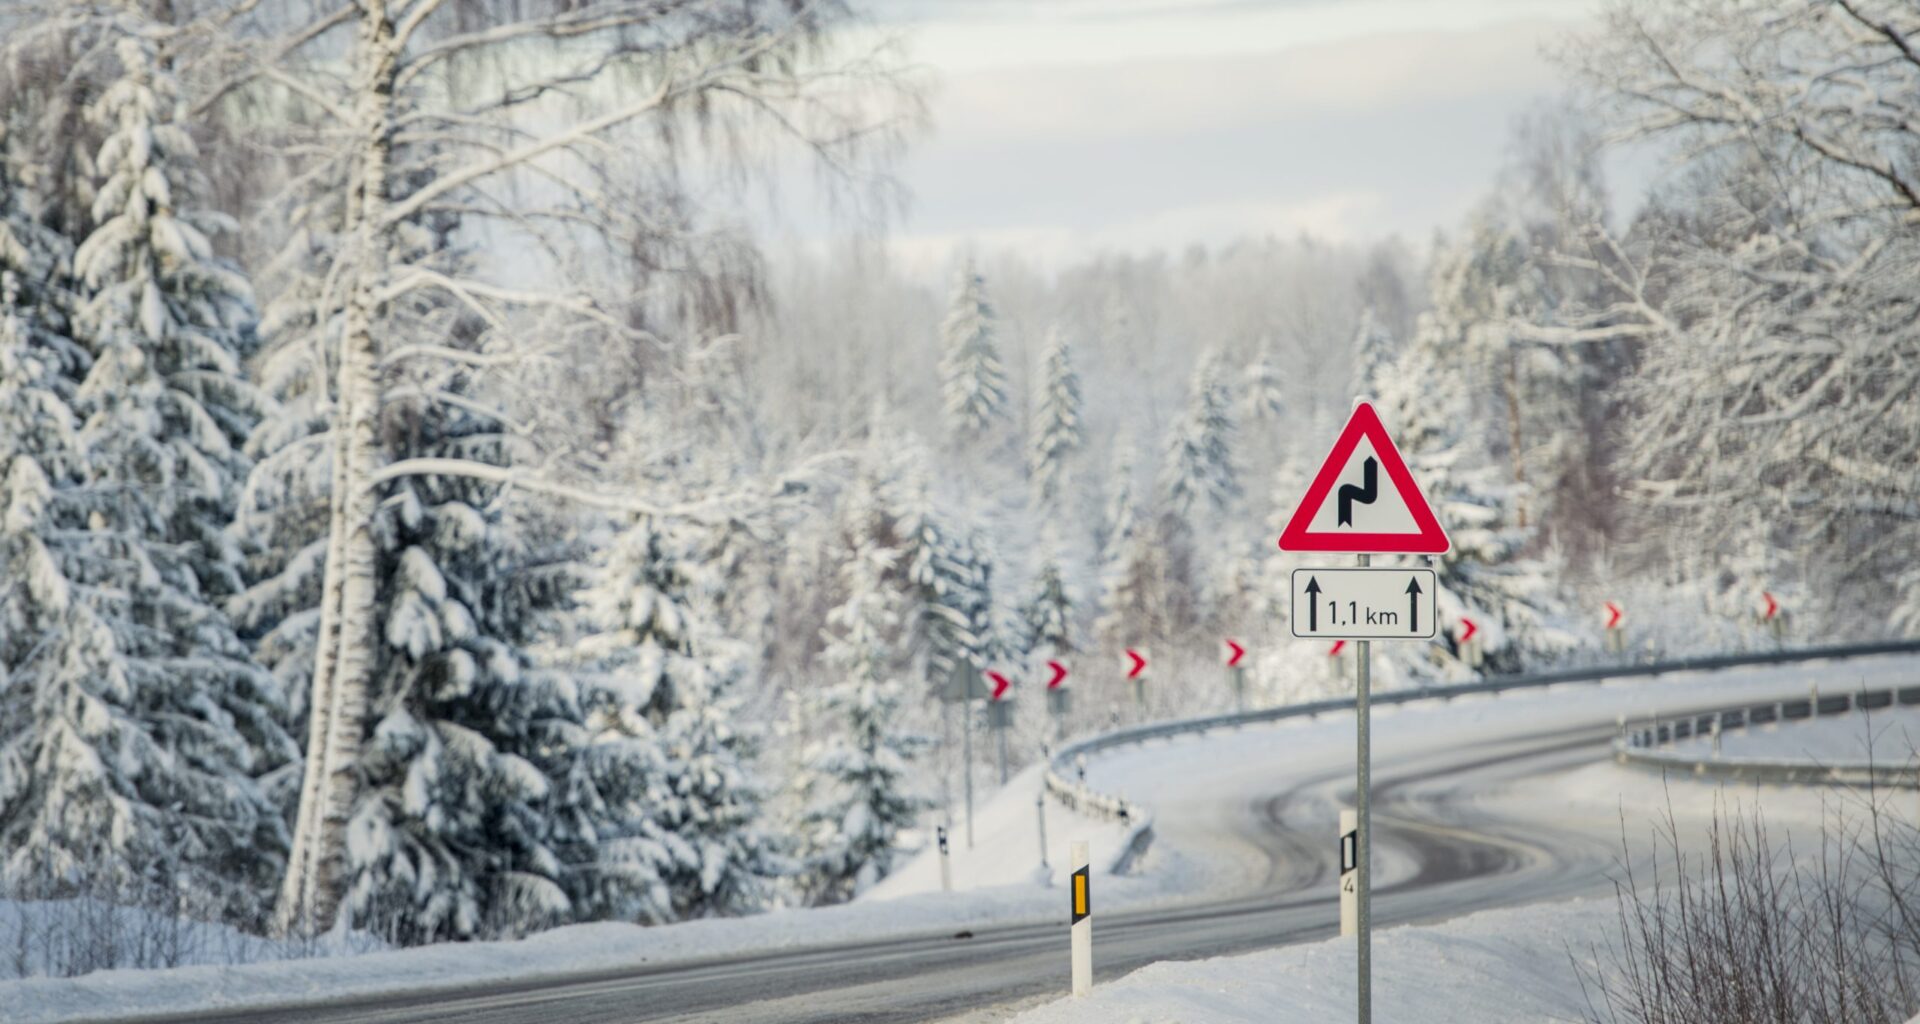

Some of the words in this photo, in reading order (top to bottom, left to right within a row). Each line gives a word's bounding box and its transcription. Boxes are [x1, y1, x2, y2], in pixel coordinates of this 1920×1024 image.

[1328, 600, 1357, 626] 1,1
[1366, 606, 1398, 625] km
[1343, 878, 1354, 894] 4
